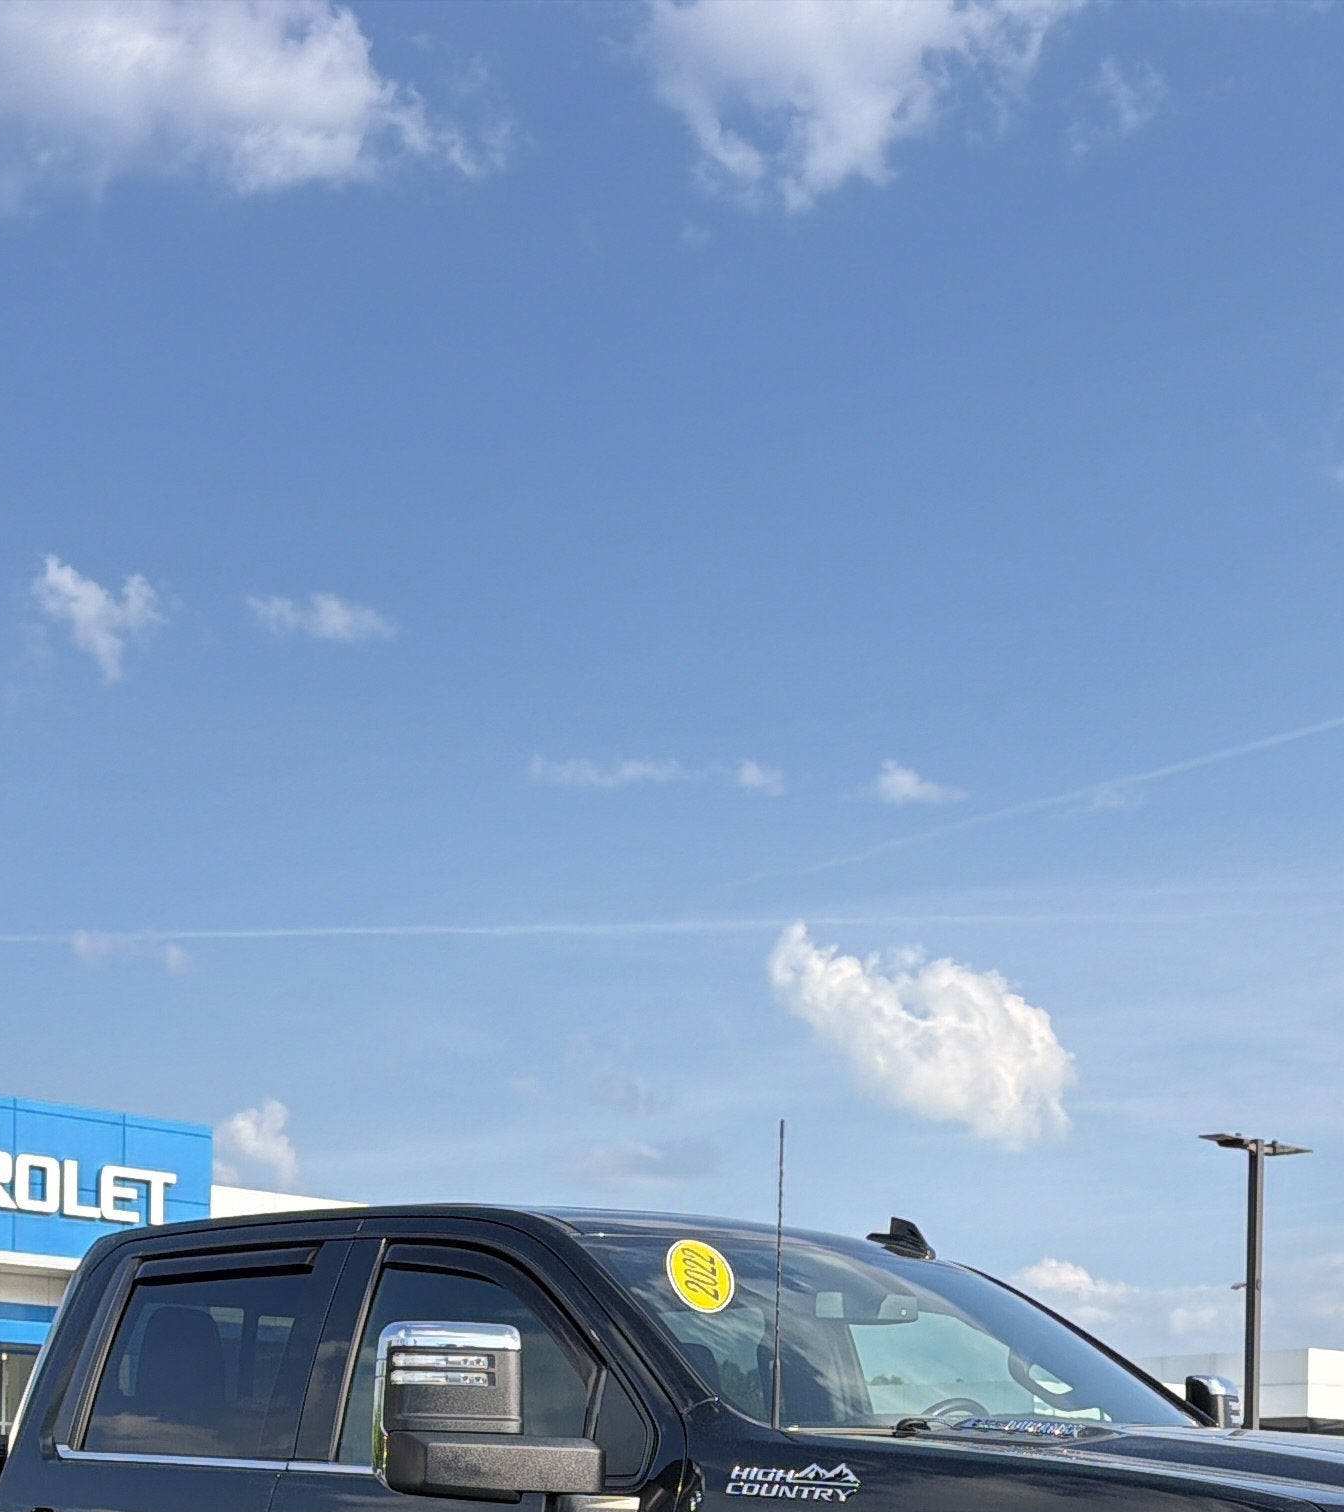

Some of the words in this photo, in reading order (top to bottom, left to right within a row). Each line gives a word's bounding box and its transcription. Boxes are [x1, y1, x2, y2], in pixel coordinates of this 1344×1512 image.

[681, 1247, 720, 1302] 2022
[729, 1465, 798, 1483] HIGH
[725, 1481, 858, 1502] COUNTRY
